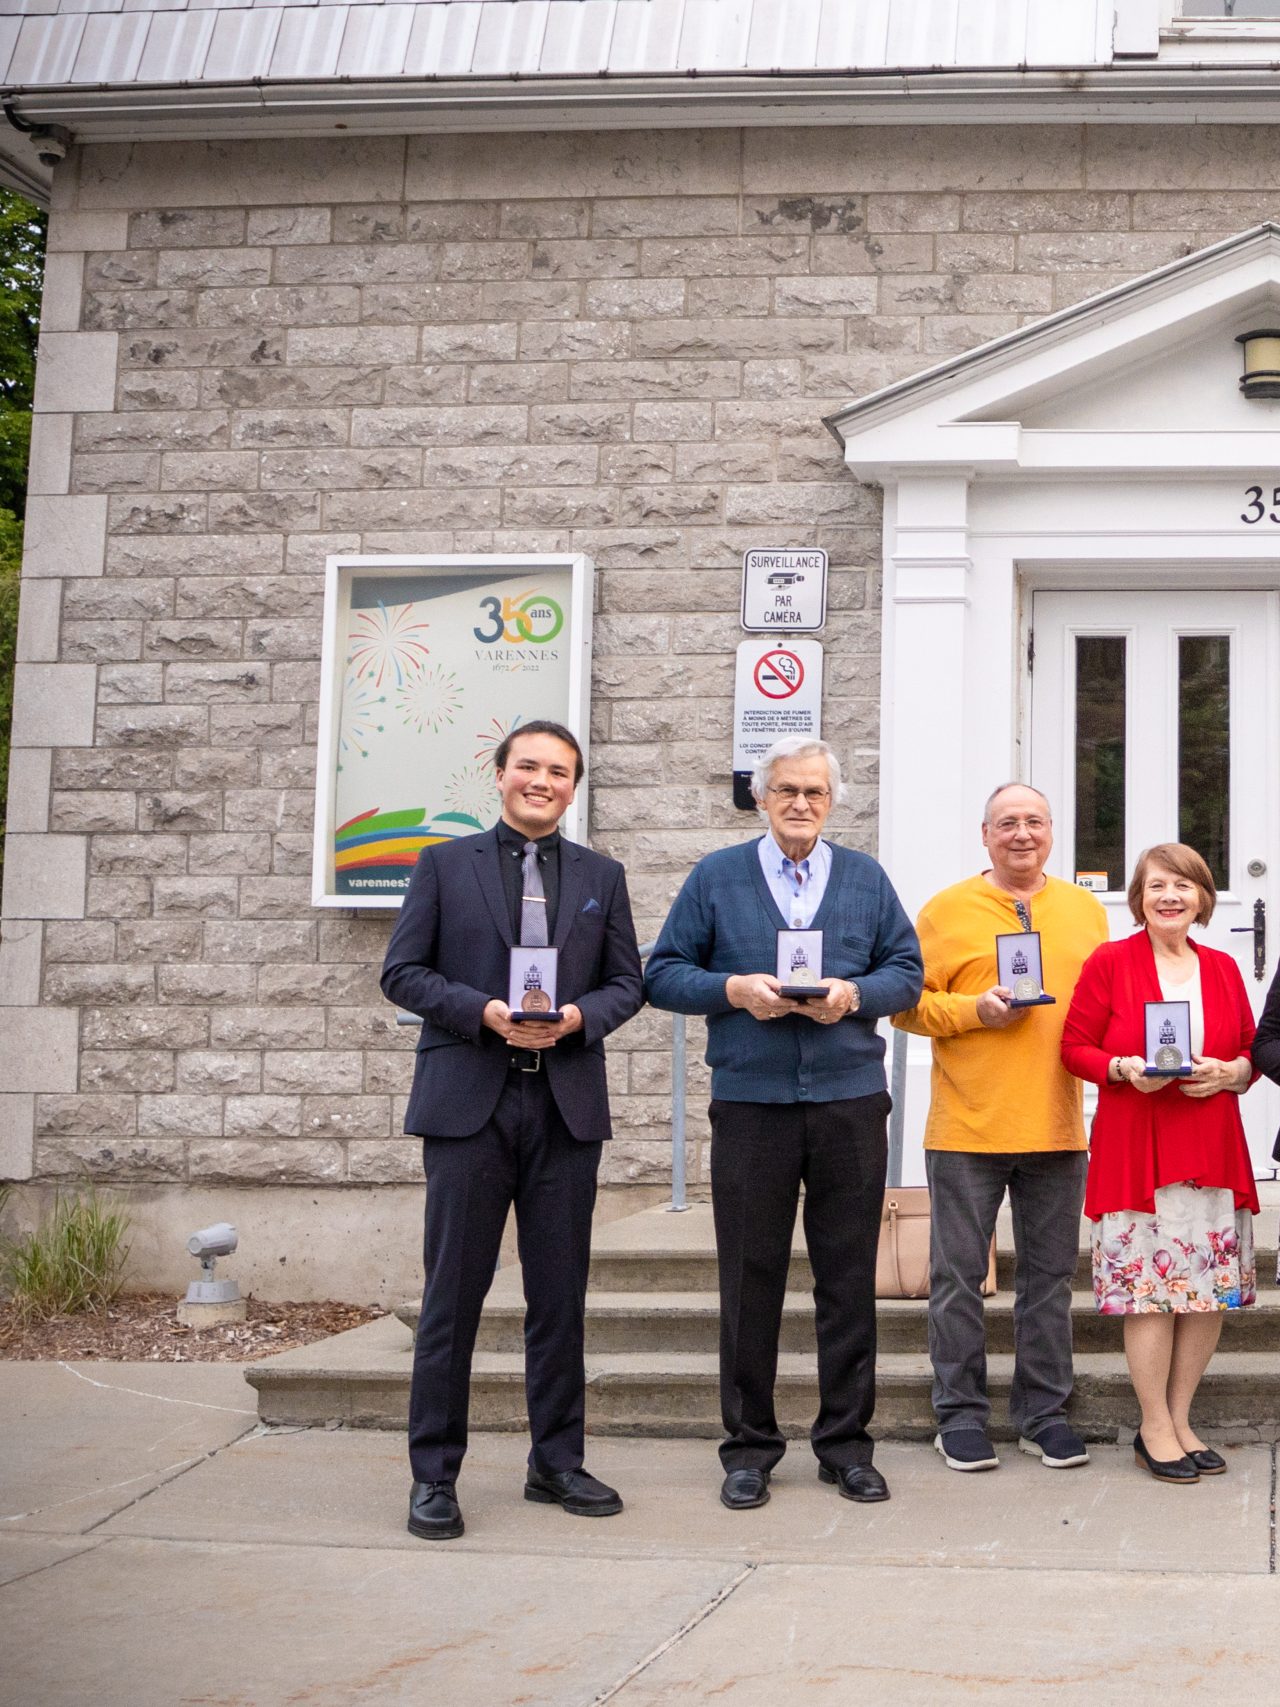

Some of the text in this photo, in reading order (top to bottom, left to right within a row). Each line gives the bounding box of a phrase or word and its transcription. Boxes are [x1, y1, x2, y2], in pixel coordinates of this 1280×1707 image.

[751, 556, 820, 568] SURVEILLANCE
[775, 595, 792, 607] PAR
[473, 588, 564, 644] 350
[530, 608, 552, 618] ans
[764, 609, 802, 623] CAMÉRA
[475, 650, 559, 660] VARENNES
